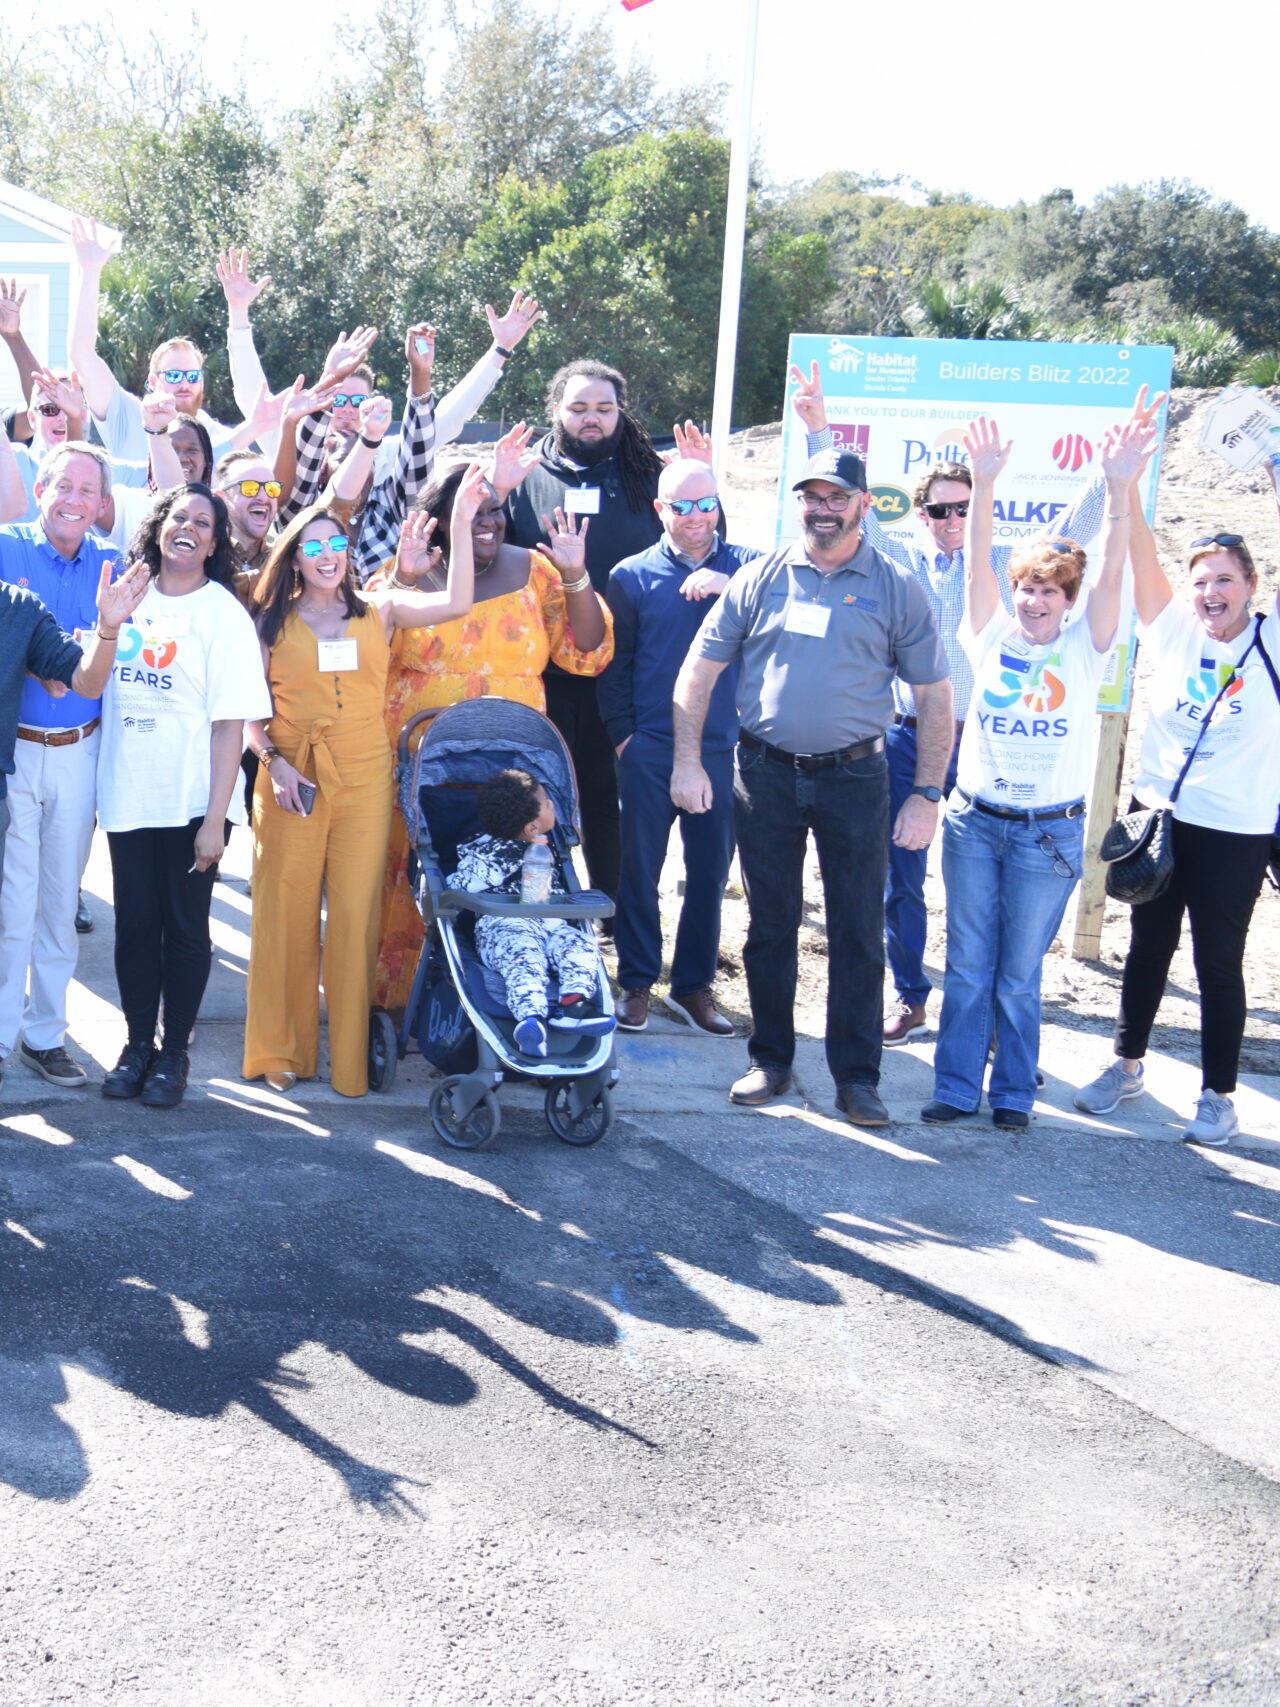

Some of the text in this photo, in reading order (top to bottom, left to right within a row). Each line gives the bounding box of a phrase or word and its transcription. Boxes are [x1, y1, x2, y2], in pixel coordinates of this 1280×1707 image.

[867, 352, 917, 367] Habitat
[939, 361, 1129, 386] Builders Blitz 2022
[854, 406, 878, 416] YOU
[882, 407, 897, 417] TO
[901, 408, 926, 418] OUR
[977, 711, 1069, 737] YEARS
